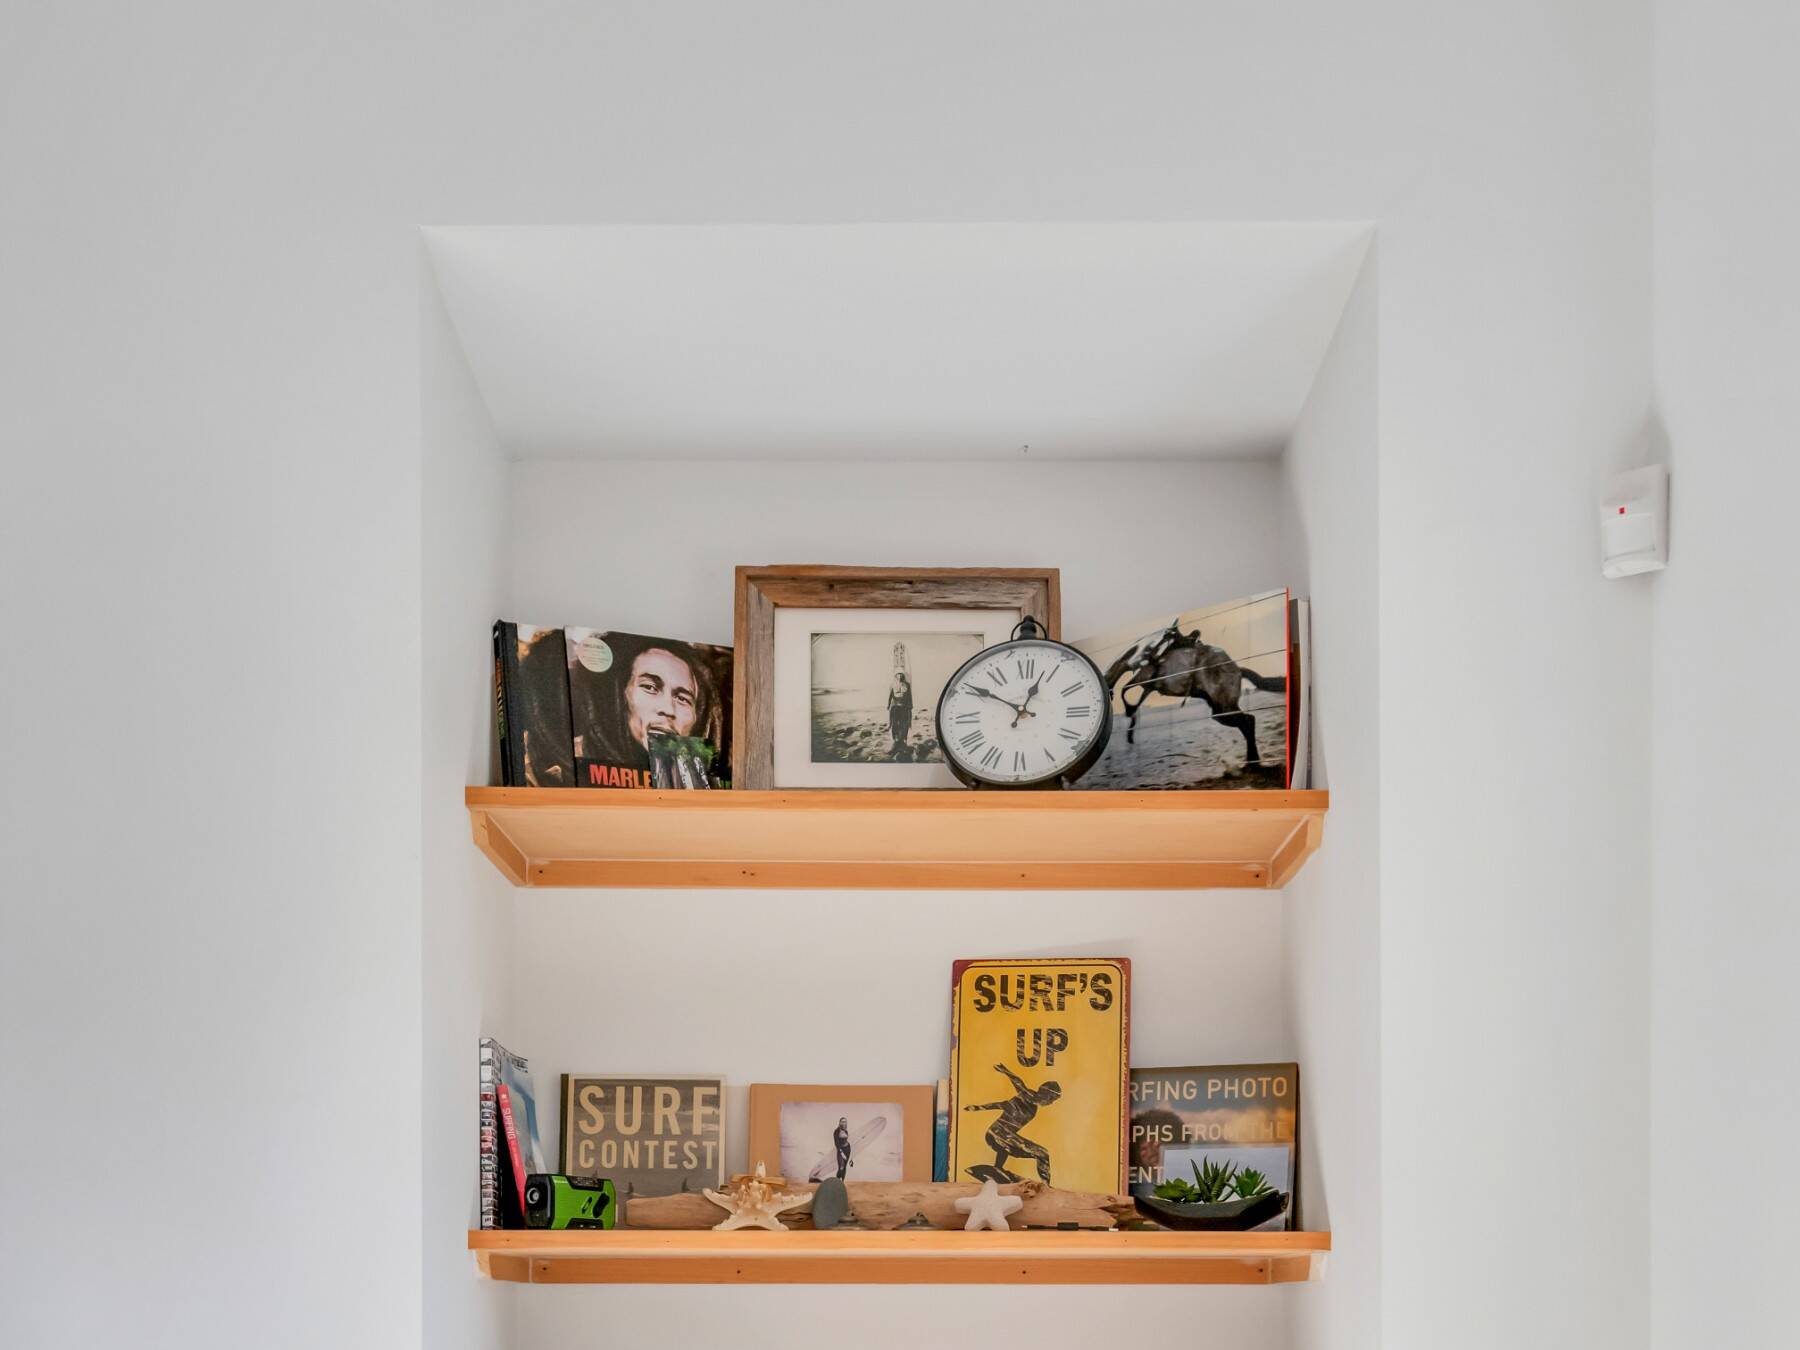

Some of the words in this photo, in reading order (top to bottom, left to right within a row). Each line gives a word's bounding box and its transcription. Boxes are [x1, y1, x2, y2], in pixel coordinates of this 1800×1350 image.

[973, 973, 1113, 1013] SURF'S
[1016, 1028, 1069, 1067] UP
[1207, 1076, 1288, 1100] PHOTO
[578, 1085, 718, 1135] SURF
[1130, 1124, 1174, 1143] PHS
[1182, 1123, 1240, 1142] FROM
[1250, 1119, 1289, 1140] THE
[579, 1139, 717, 1169] CONTEST
